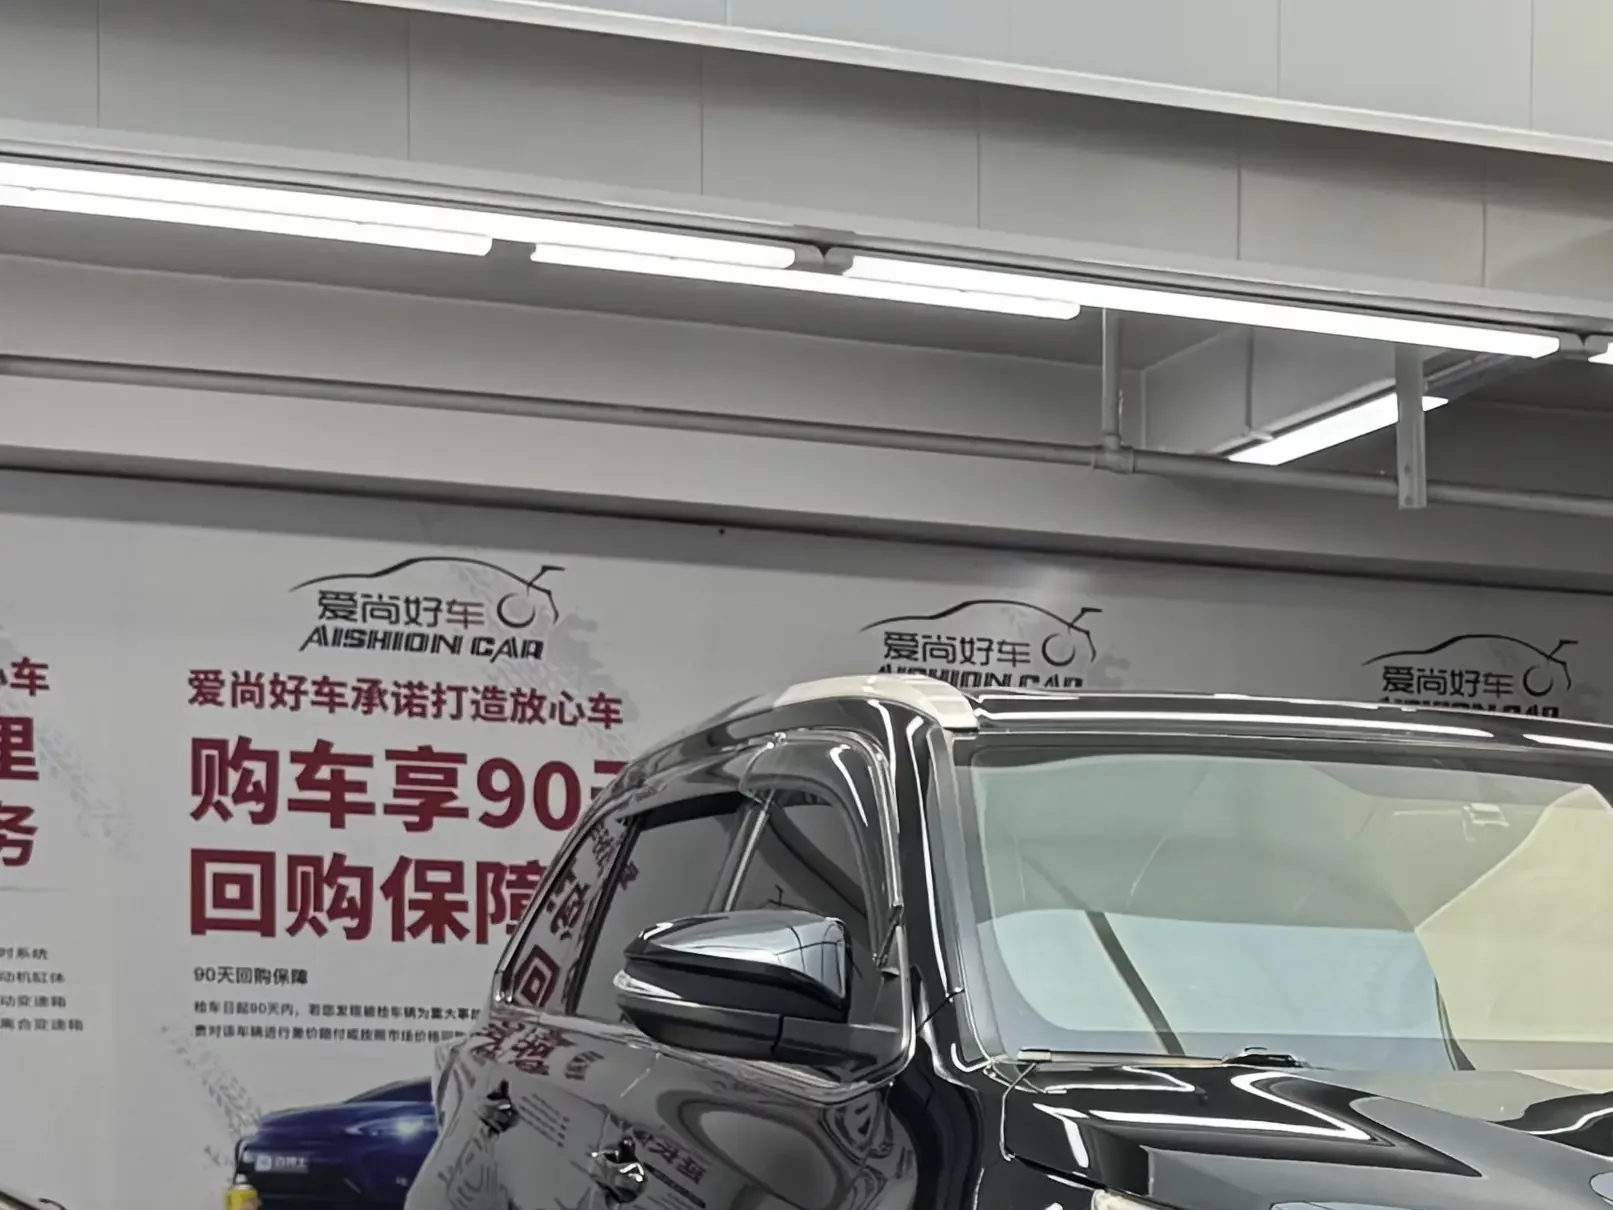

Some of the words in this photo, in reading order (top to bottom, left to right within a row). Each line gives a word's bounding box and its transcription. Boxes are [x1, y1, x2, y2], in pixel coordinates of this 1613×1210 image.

[318, 589, 485, 629] 爱尚好车
[470, 636, 544, 664] CAR
[884, 631, 1031, 668] 爱尚好车
[0, 656, 50, 696] 车
[1382, 665, 1513, 698] 爱尚好车
[187, 669, 624, 729] 爱尚好车承诺打造放心车
[193, 966, 309, 987] 90天回购保障
